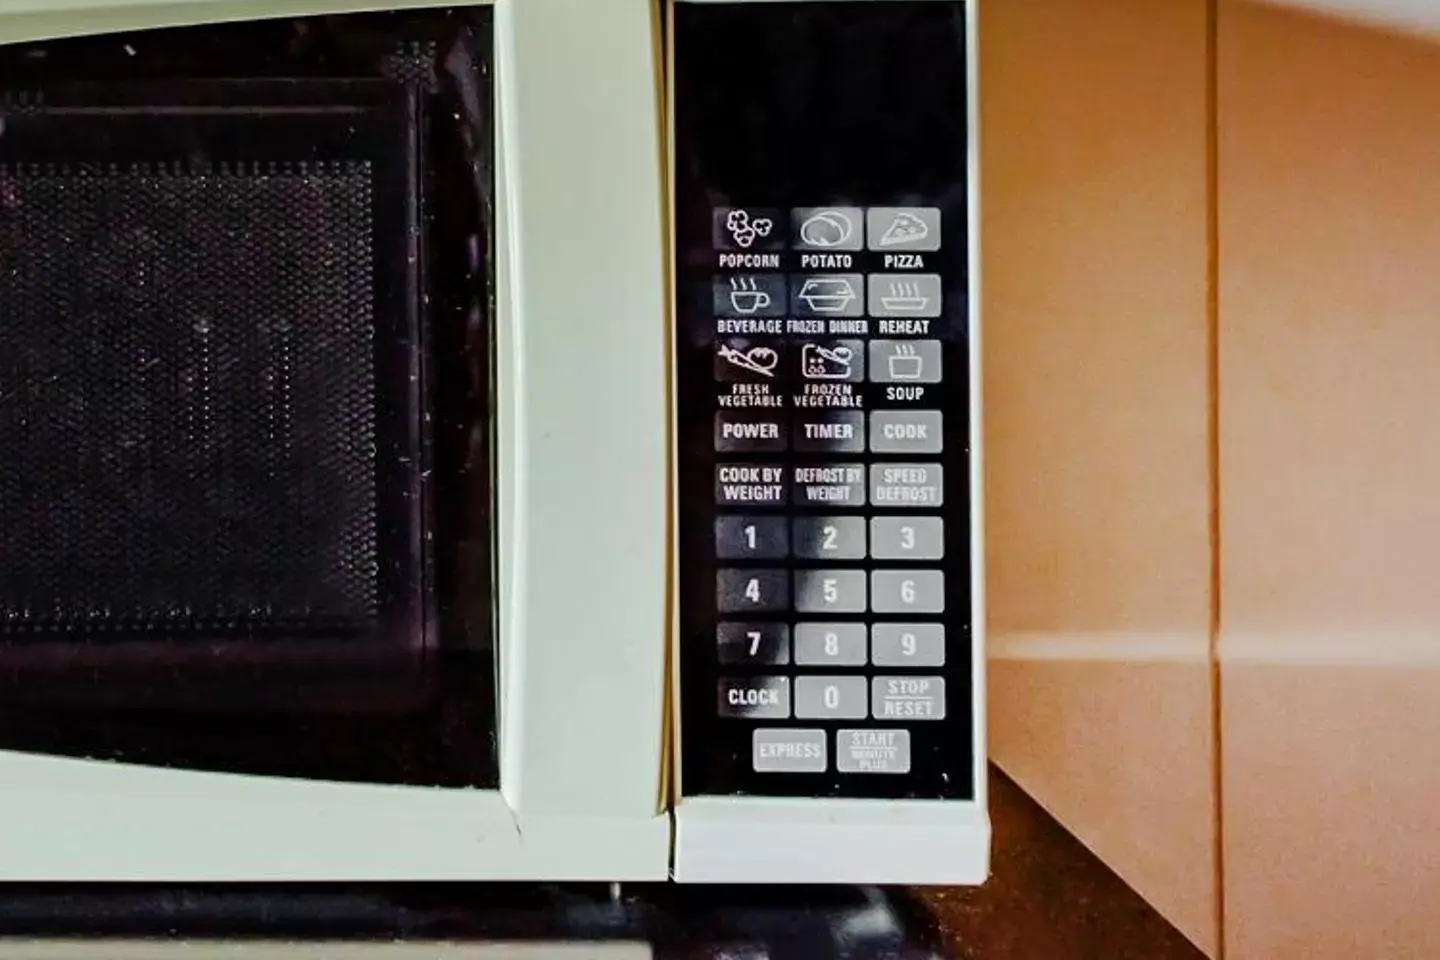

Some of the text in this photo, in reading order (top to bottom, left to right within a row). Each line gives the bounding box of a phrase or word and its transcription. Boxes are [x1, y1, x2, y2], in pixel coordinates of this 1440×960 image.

[720, 255, 780, 268] POPCORN
[802, 256, 852, 268] POTATO
[884, 256, 924, 268] PIZZA
[718, 320, 782, 333] BEVERAGE
[787, 320, 868, 334] FROZEN DINNER
[879, 320, 930, 334] REHEAT
[732, 384, 769, 394] FRESH
[804, 384, 852, 394] FROZEN
[886, 388, 924, 400] SOUP
[718, 396, 783, 406] VEGETABLE
[794, 396, 863, 407] VEGETABLE
[723, 424, 778, 438] POWER
[805, 424, 853, 438] TIMER
[884, 424, 927, 438] COOK
[720, 469, 782, 482] COOK BY
[796, 469, 862, 482] DEFROST BY
[884, 469, 927, 482] SPEED
[724, 487, 782, 500] WEIGHT
[806, 487, 850, 500] WEIGHT
[877, 487, 936, 500] DEFROST
[745, 526, 755, 548] 1
[823, 527, 838, 549] 2
[901, 527, 914, 549] 3
[746, 580, 760, 602] 4
[824, 580, 837, 602] 5
[901, 581, 915, 603] 6
[748, 633, 760, 655] 7
[825, 633, 838, 655] 8
[902, 634, 915, 656] 9
[888, 681, 929, 694] STOP
[729, 689, 779, 704] CLOCK
[825, 686, 838, 708] 0
[885, 702, 932, 716] RESET
[852, 733, 895, 745] START
[760, 743, 820, 758] EXPRESS
